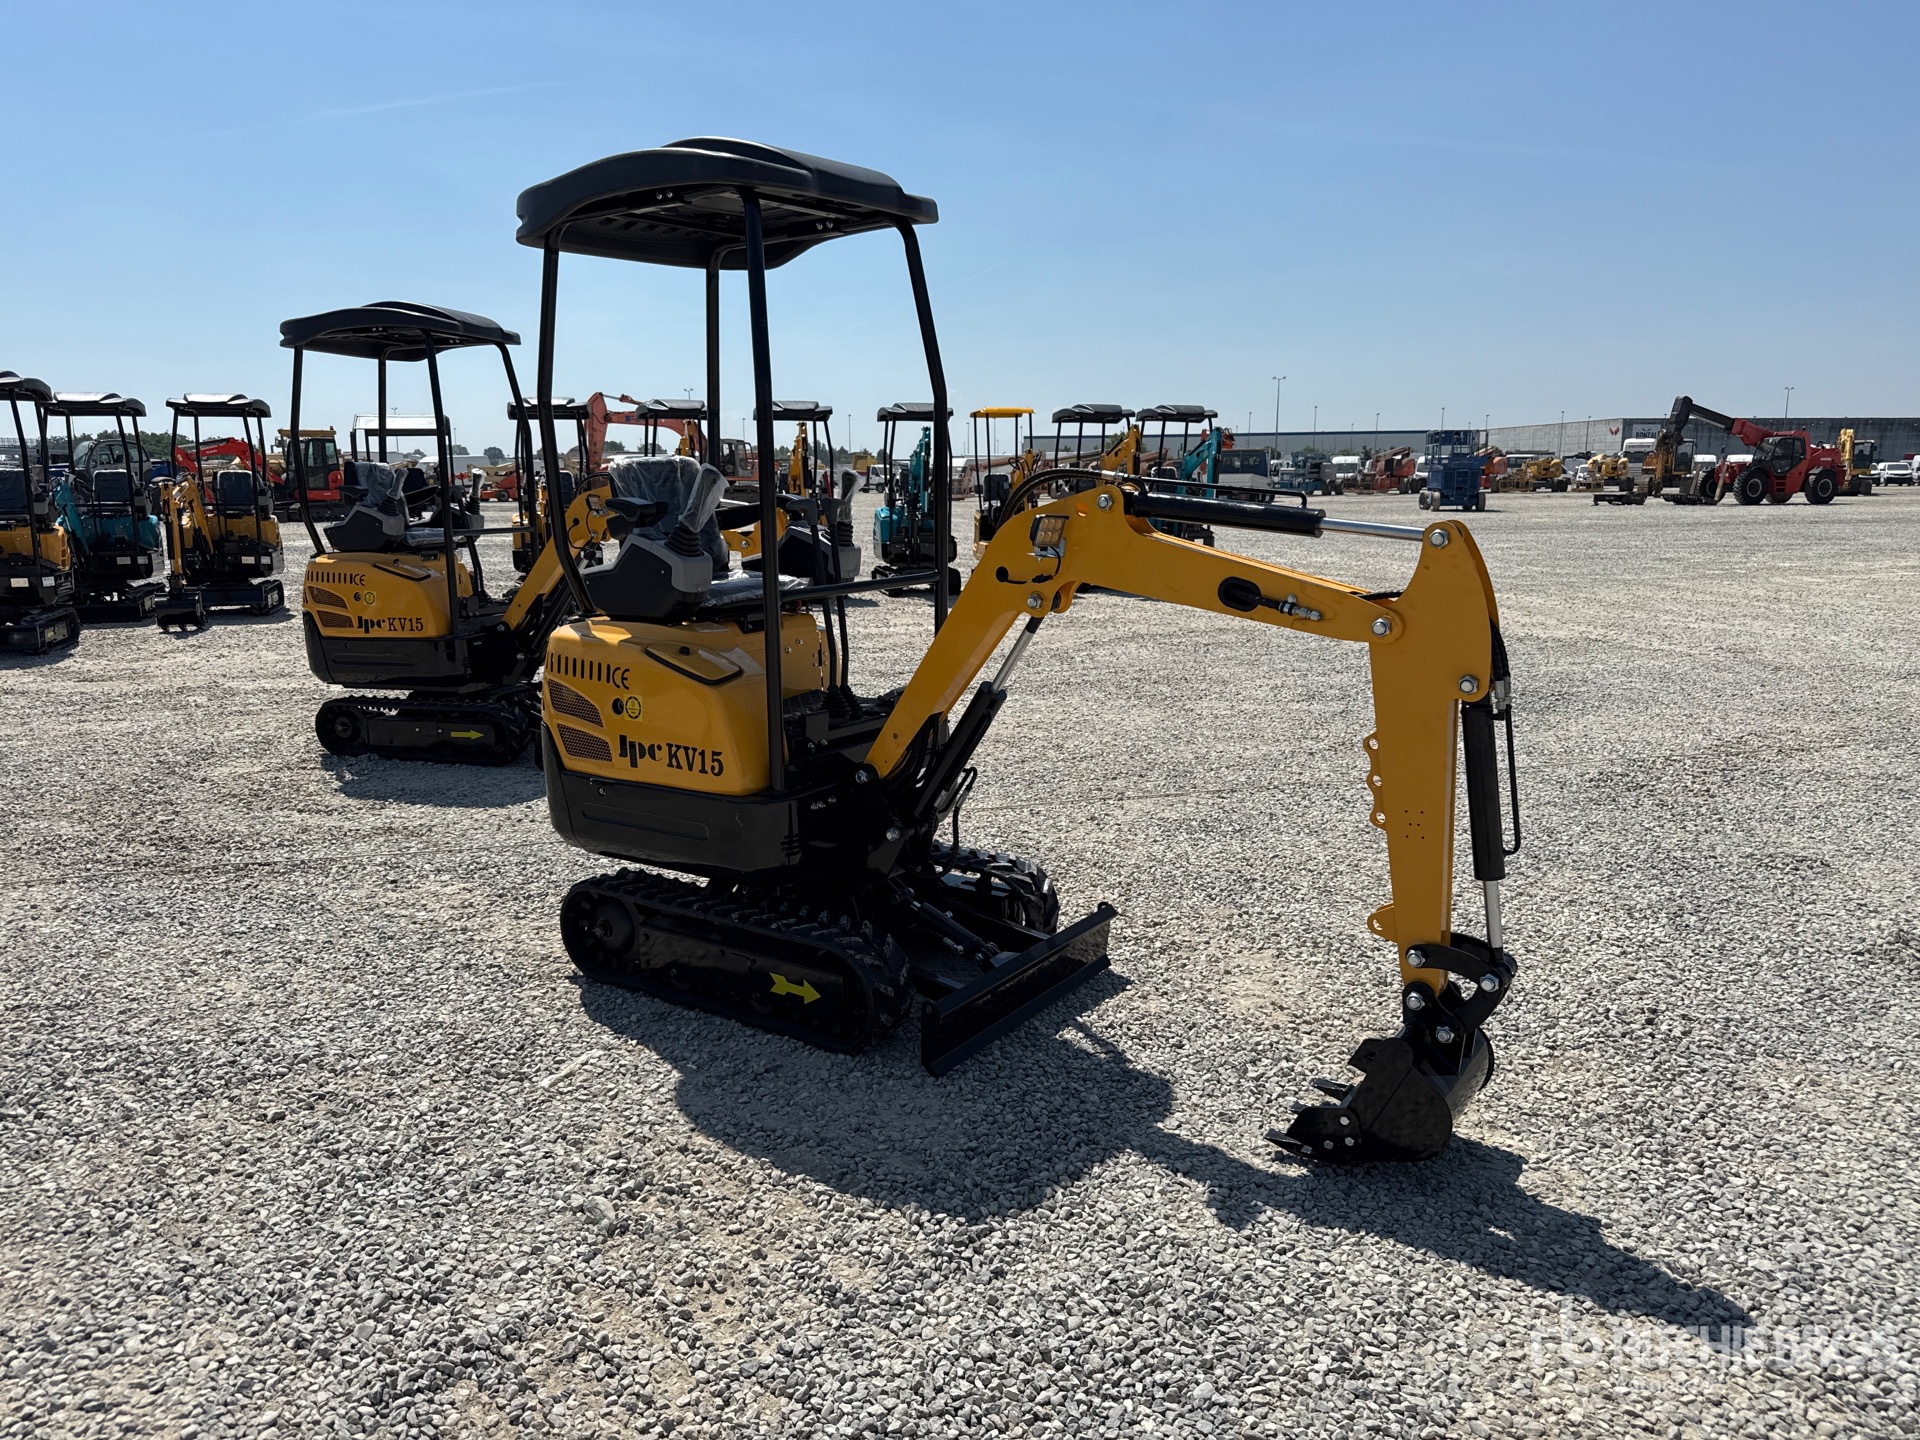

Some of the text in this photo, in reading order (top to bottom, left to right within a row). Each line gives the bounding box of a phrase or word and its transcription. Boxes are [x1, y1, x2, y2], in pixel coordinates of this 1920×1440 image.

[387, 617, 424, 632] KV15
[612, 667, 630, 690] CE
[666, 742, 724, 777] KV15
